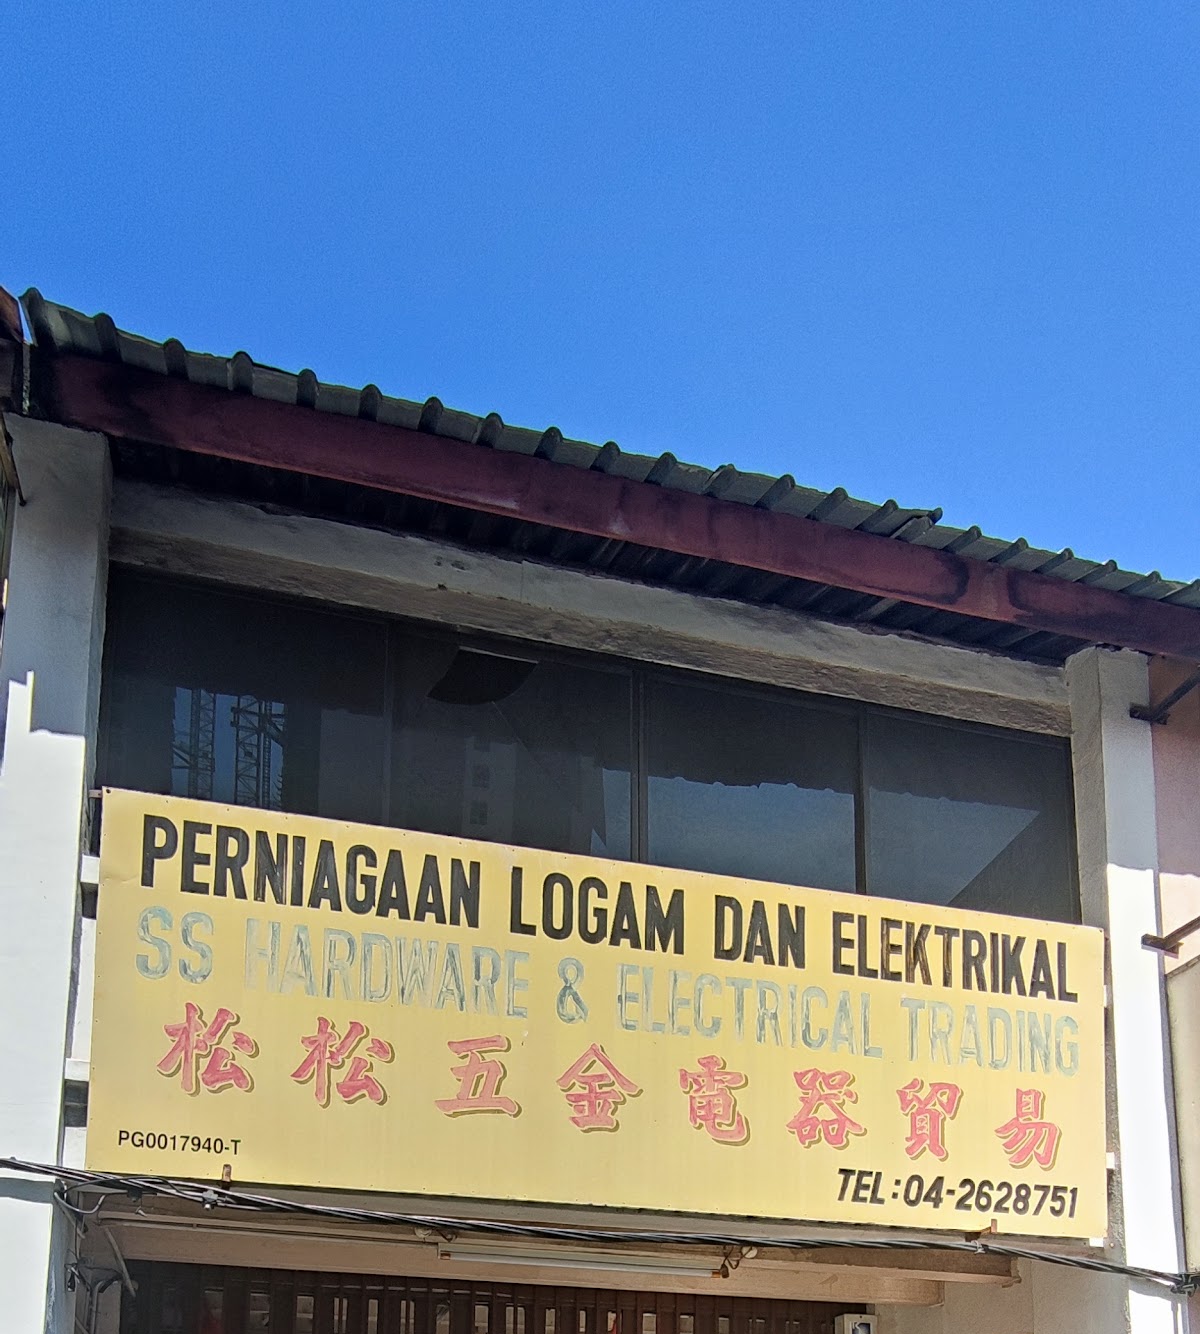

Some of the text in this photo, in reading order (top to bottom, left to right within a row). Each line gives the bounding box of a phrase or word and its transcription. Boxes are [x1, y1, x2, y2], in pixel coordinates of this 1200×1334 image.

[135, 906, 1080, 1077] SS HARDWARE & ELECTRICAL TRADING
[141, 814, 1078, 1003] PERNIAGAAN LOGAM DAN ELEKTRIKAL
[117, 1130, 242, 1157] PG0017940-T
[156, 1002, 1063, 1171] 松松五金電器貿易
